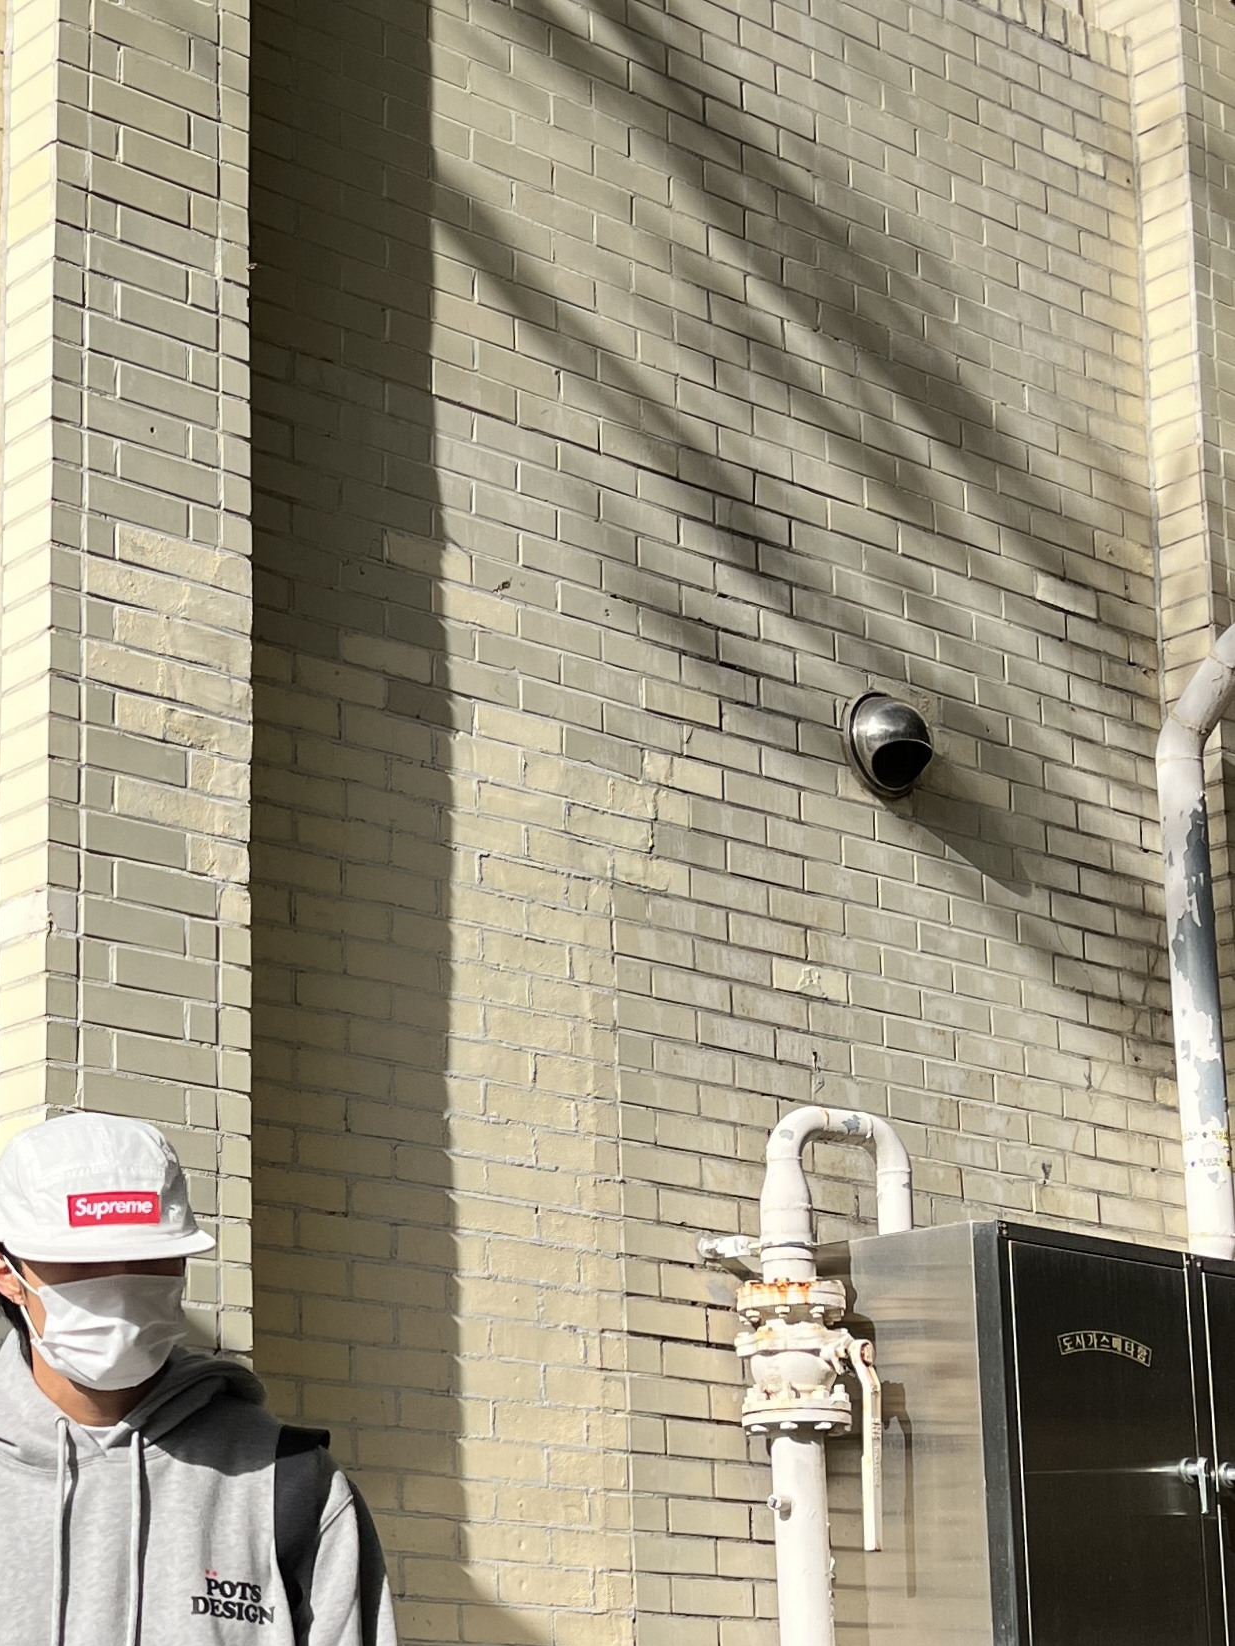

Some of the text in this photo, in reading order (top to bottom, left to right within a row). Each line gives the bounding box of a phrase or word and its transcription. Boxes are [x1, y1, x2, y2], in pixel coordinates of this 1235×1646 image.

[74, 1197, 153, 1221] Supreme
[205, 1577, 262, 1603] POTS
[190, 1596, 276, 1625] DESIGN
